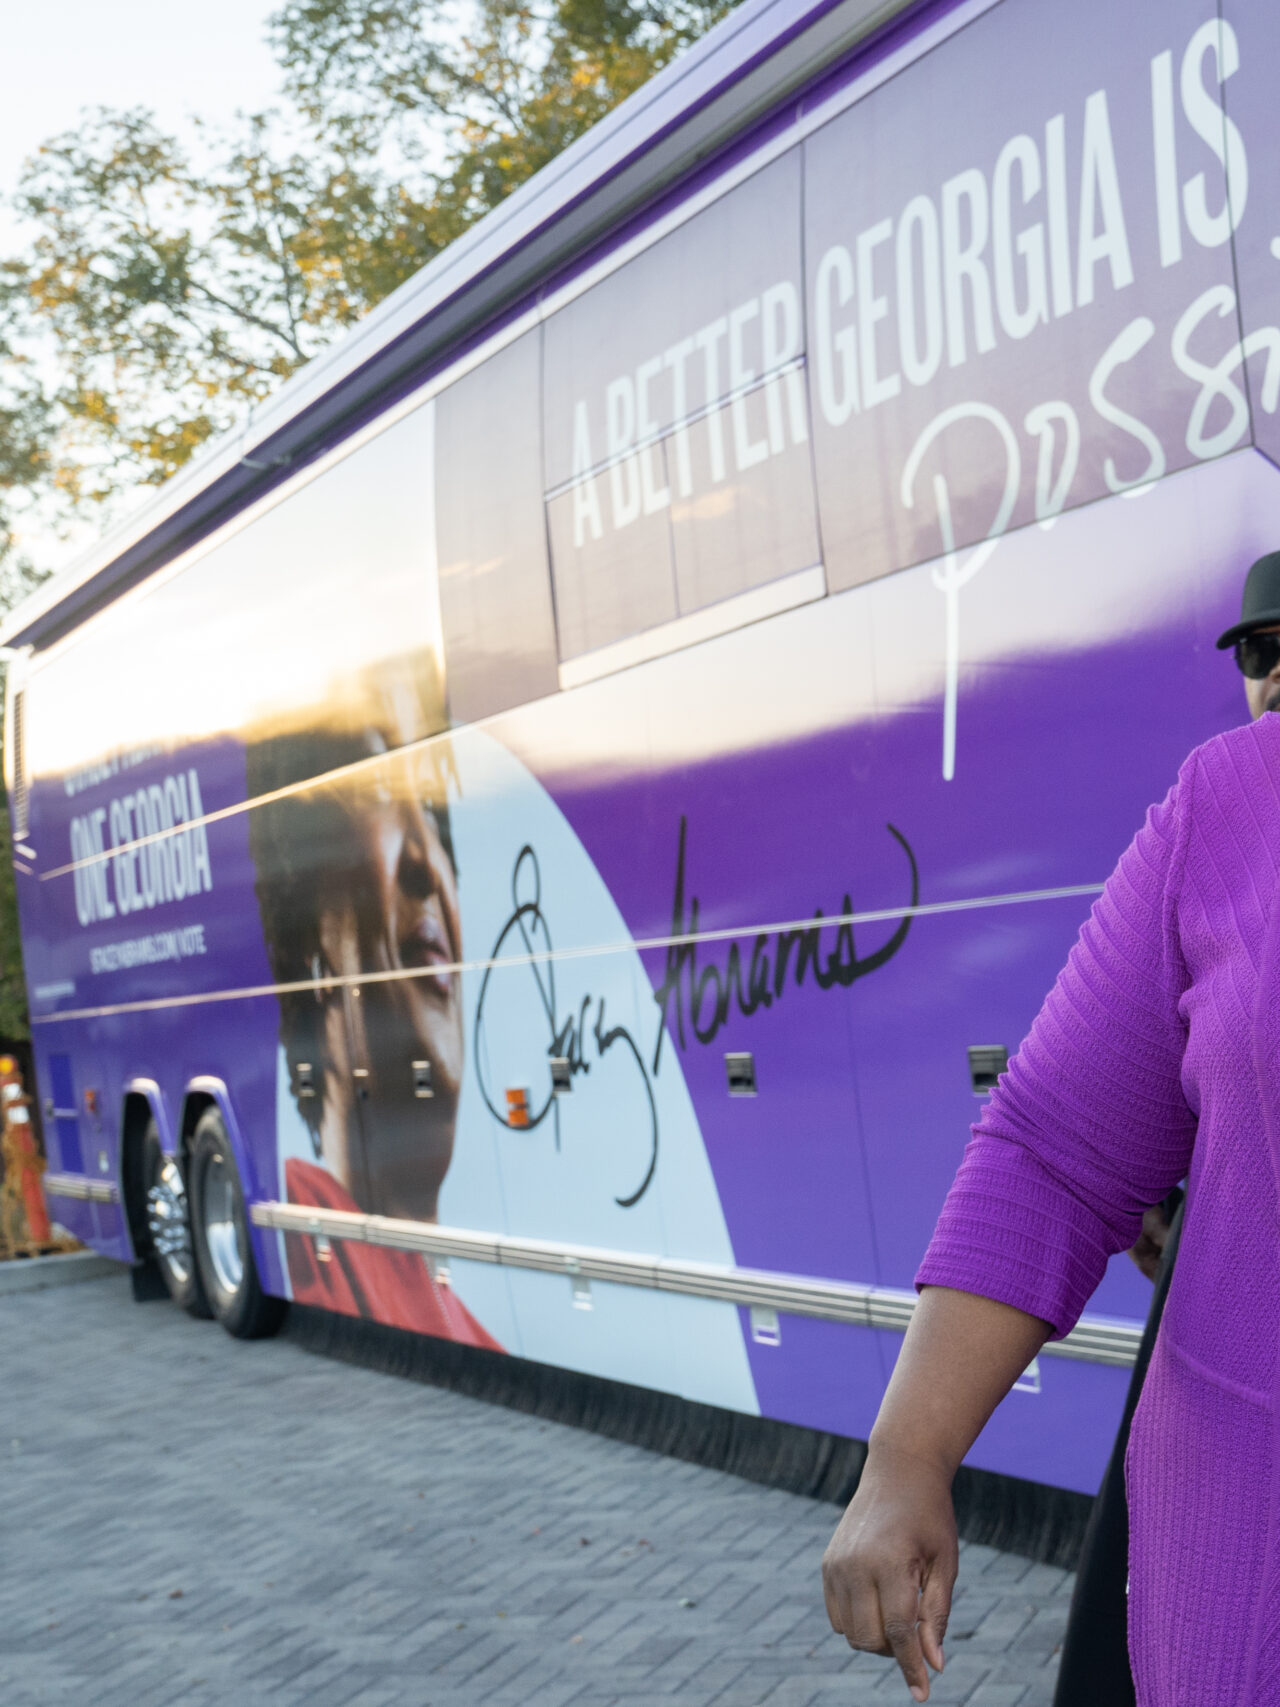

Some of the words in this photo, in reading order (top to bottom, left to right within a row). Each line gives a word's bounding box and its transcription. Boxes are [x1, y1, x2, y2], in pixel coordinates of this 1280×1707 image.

[572, 400, 603, 547] A
[606, 280, 808, 530] BETTER
[814, 89, 1135, 428] GEORGIA
[1151, 17, 1249, 268] IS
[109, 768, 213, 916] GEORGIA
